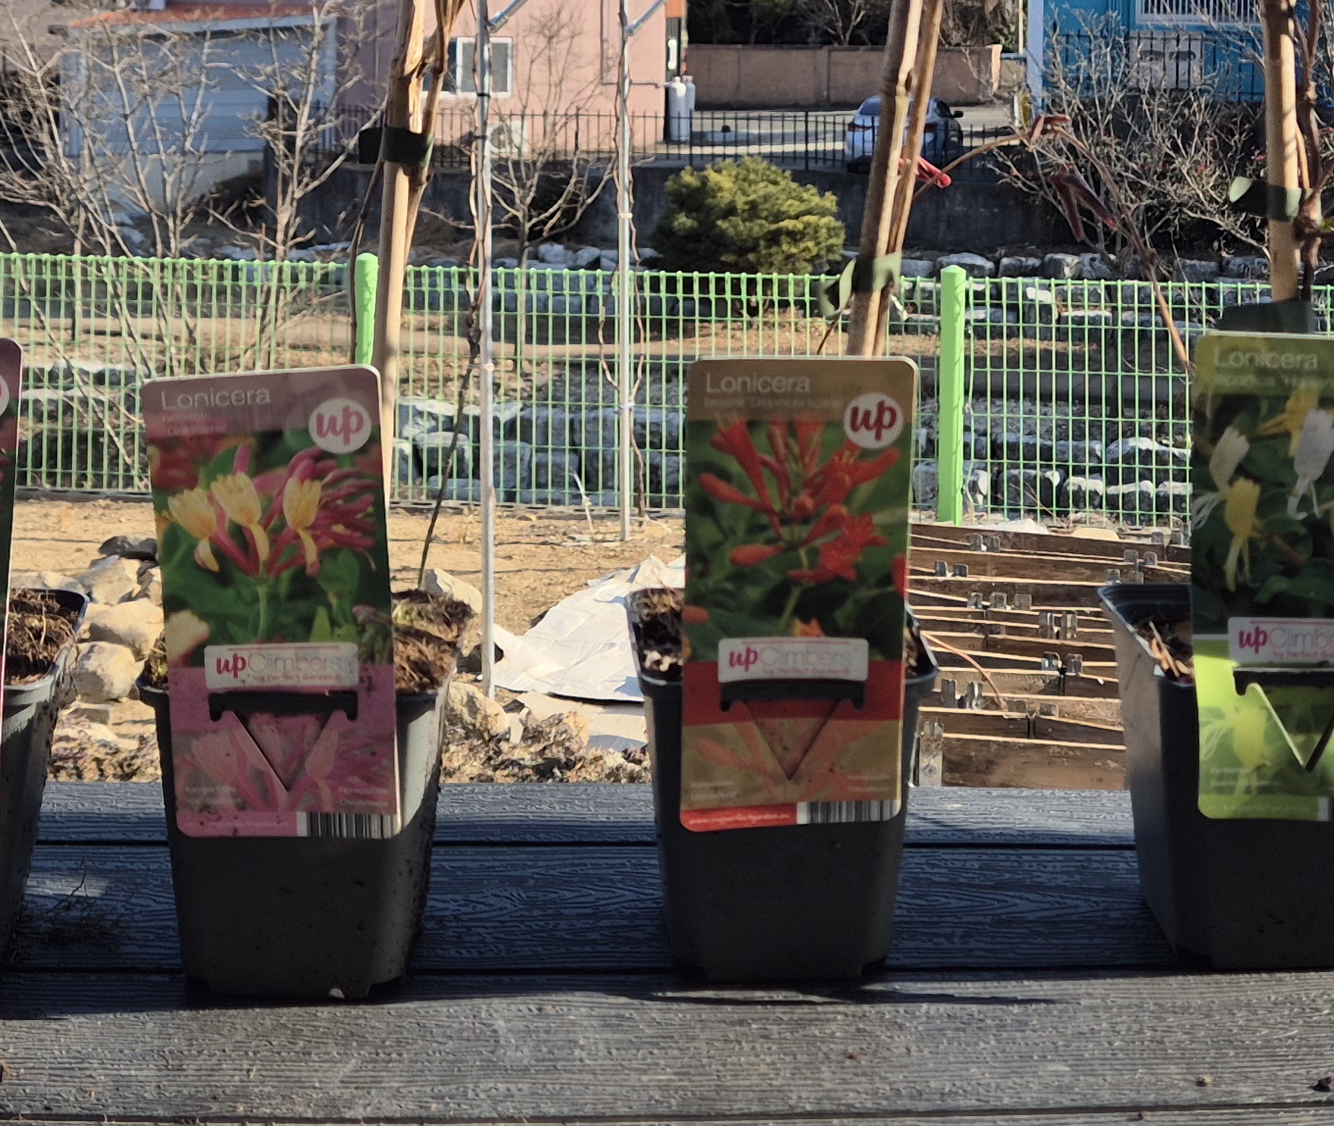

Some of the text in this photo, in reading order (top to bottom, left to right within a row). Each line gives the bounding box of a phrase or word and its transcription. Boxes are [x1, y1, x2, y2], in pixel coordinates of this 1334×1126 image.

[1214, 347, 1318, 370] Lonicera
[705, 372, 811, 394] Lonicera
[161, 387, 271, 411] Lonicera
[316, 405, 365, 447] up
[849, 398, 897, 442] up
